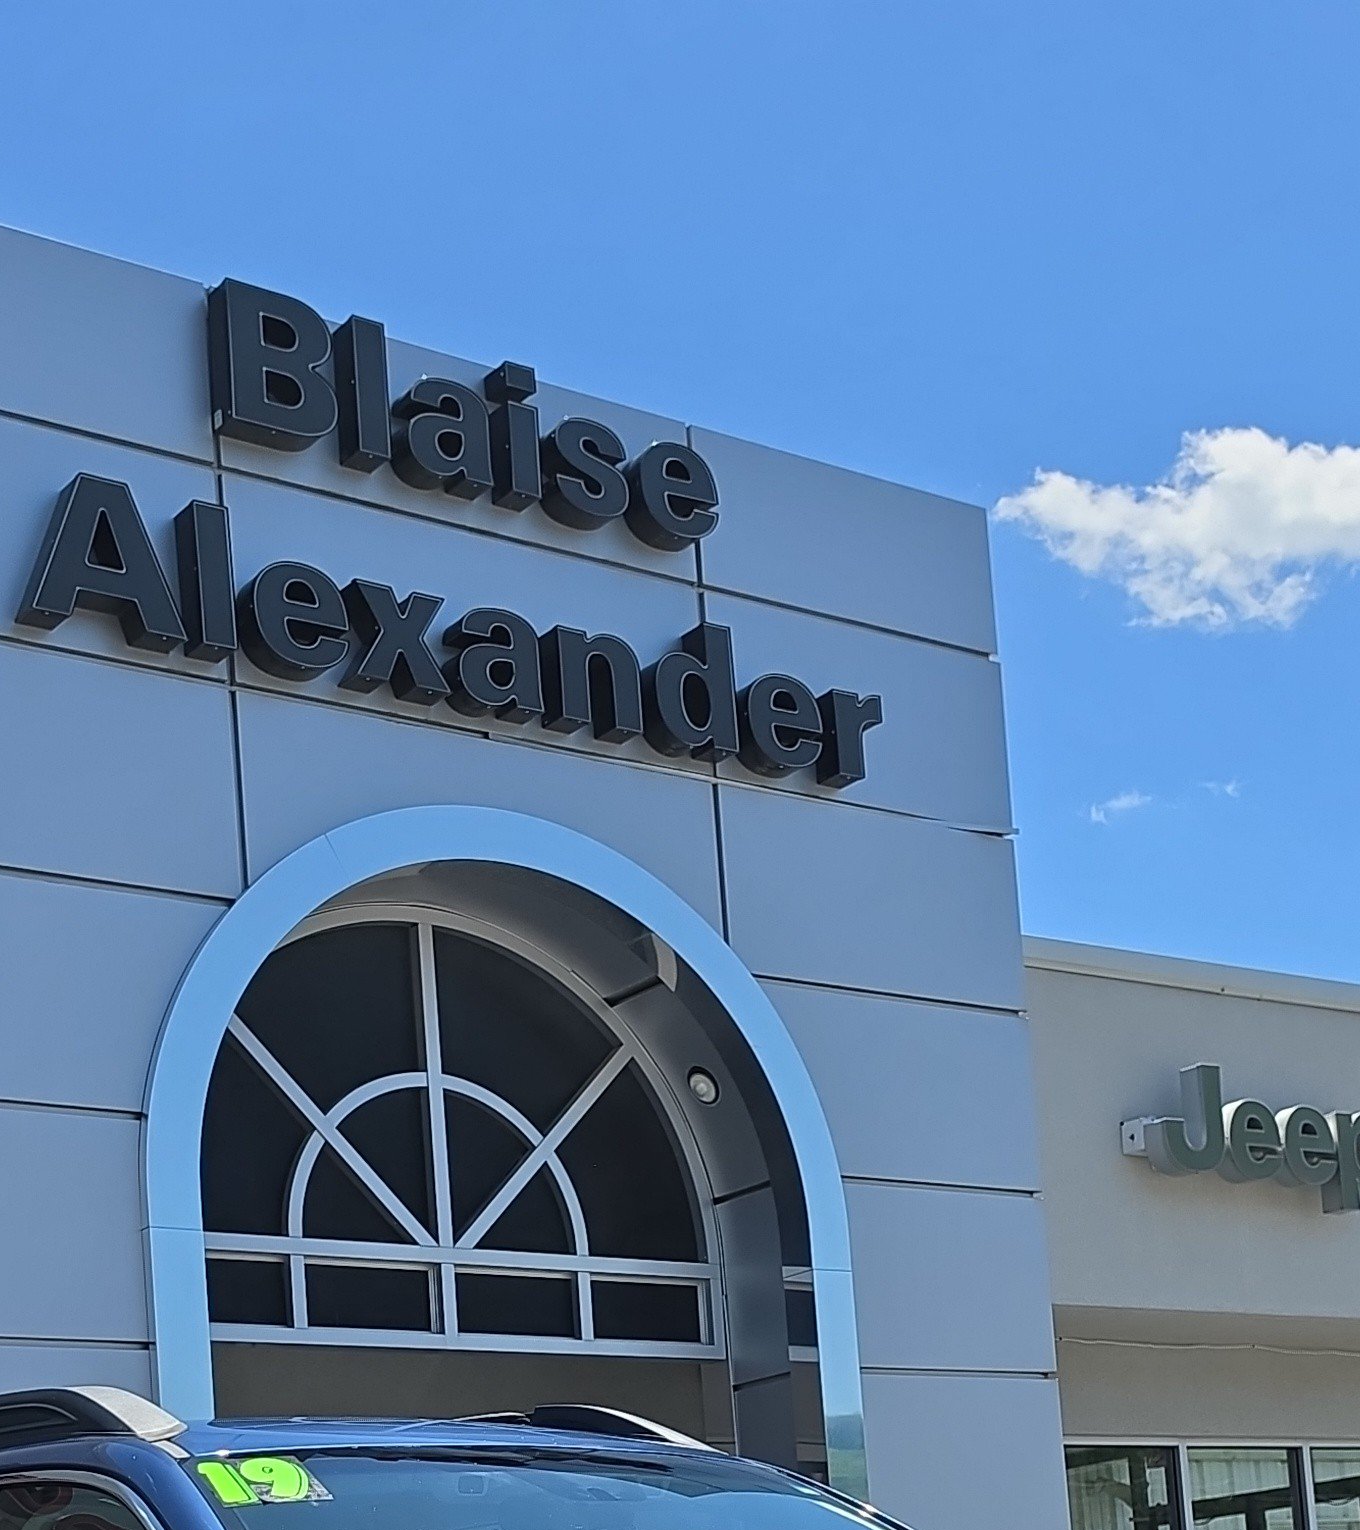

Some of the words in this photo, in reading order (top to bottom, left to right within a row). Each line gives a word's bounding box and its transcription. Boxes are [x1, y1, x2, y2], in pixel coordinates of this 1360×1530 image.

[207, 277, 720, 552] Blaise
[15, 471, 883, 790] Alexander
[196, 1456, 311, 1505] 19
